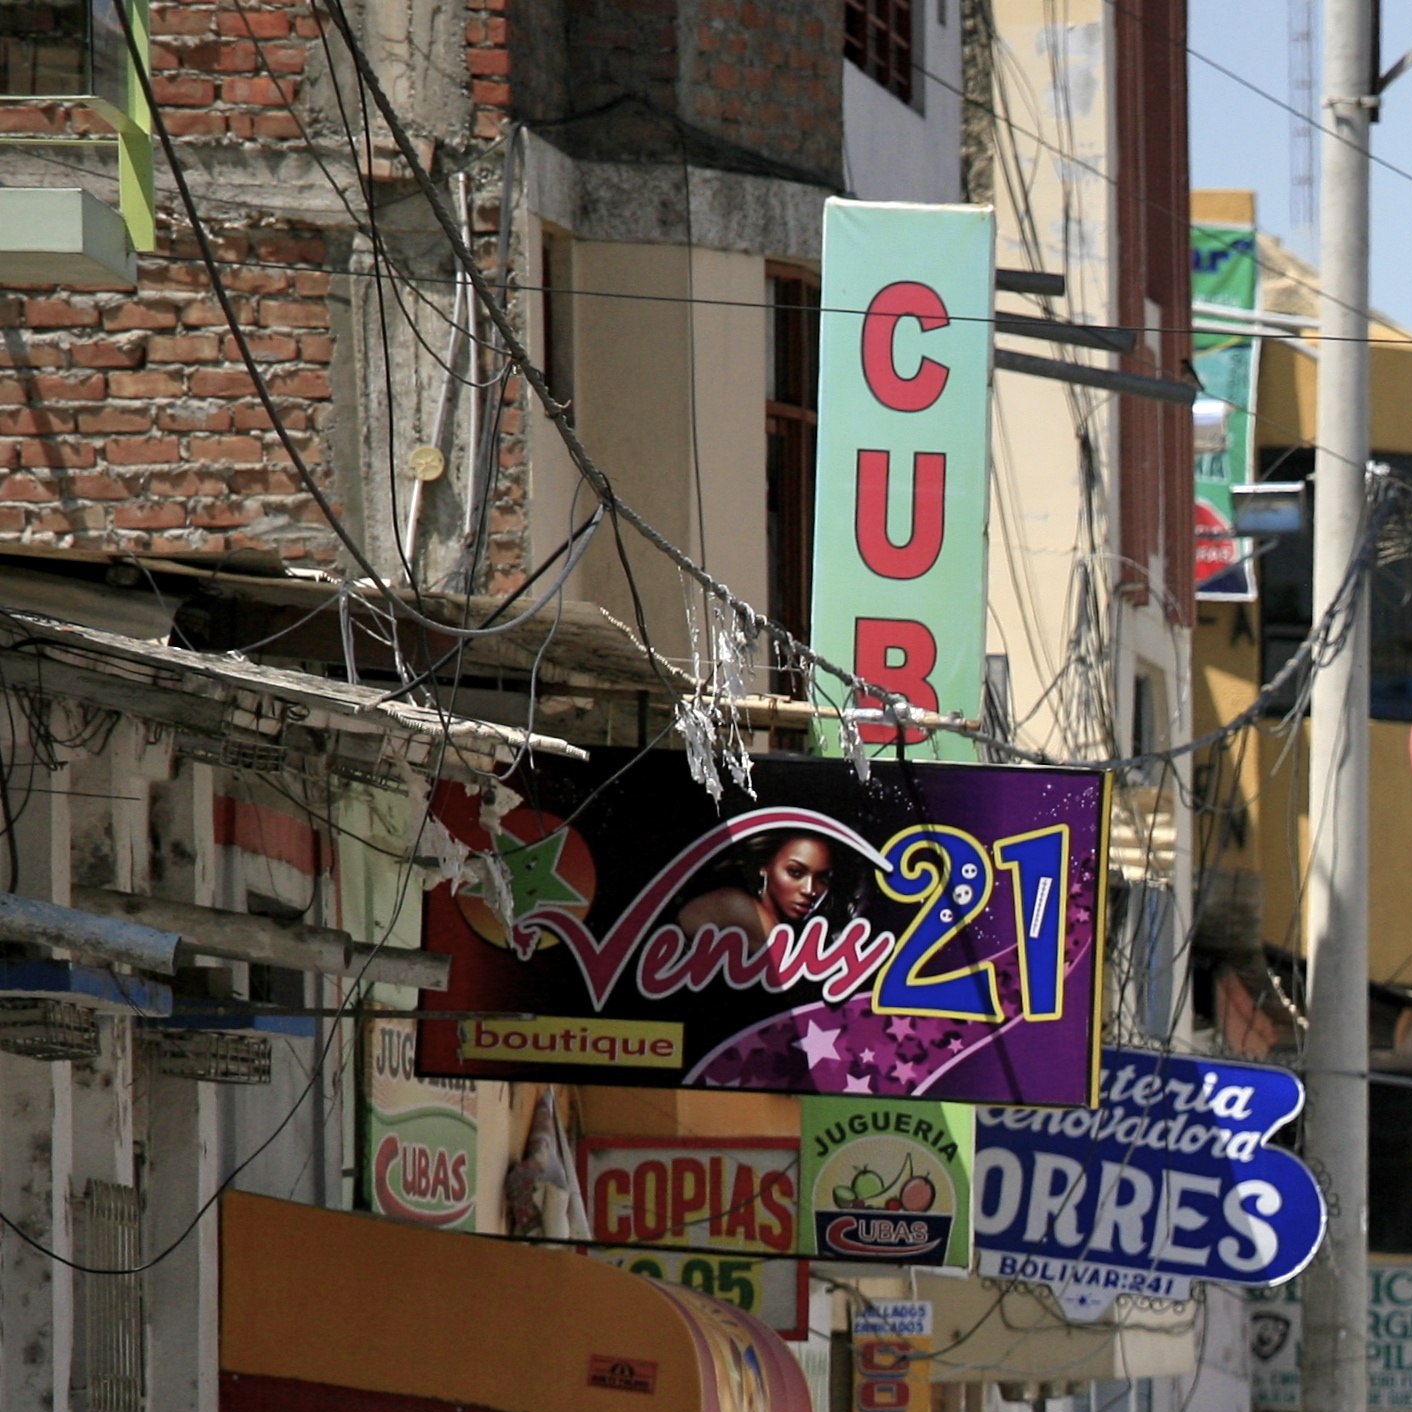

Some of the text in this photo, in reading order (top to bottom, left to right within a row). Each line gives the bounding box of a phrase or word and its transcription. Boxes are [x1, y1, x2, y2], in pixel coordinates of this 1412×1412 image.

[853, 279, 951, 745] CUB
[513, 806, 1071, 1024] Venus 21
[473, 1021, 675, 1060] boutique
[814, 1111, 961, 1164] JUGUERIA
[1099, 1064, 1256, 1121] teria
[375, 1133, 474, 1226] CUBAS
[594, 1155, 795, 1253] COPIAS
[973, 1146, 1283, 1273] ORRES
[825, 1215, 942, 1257] CUBAS
